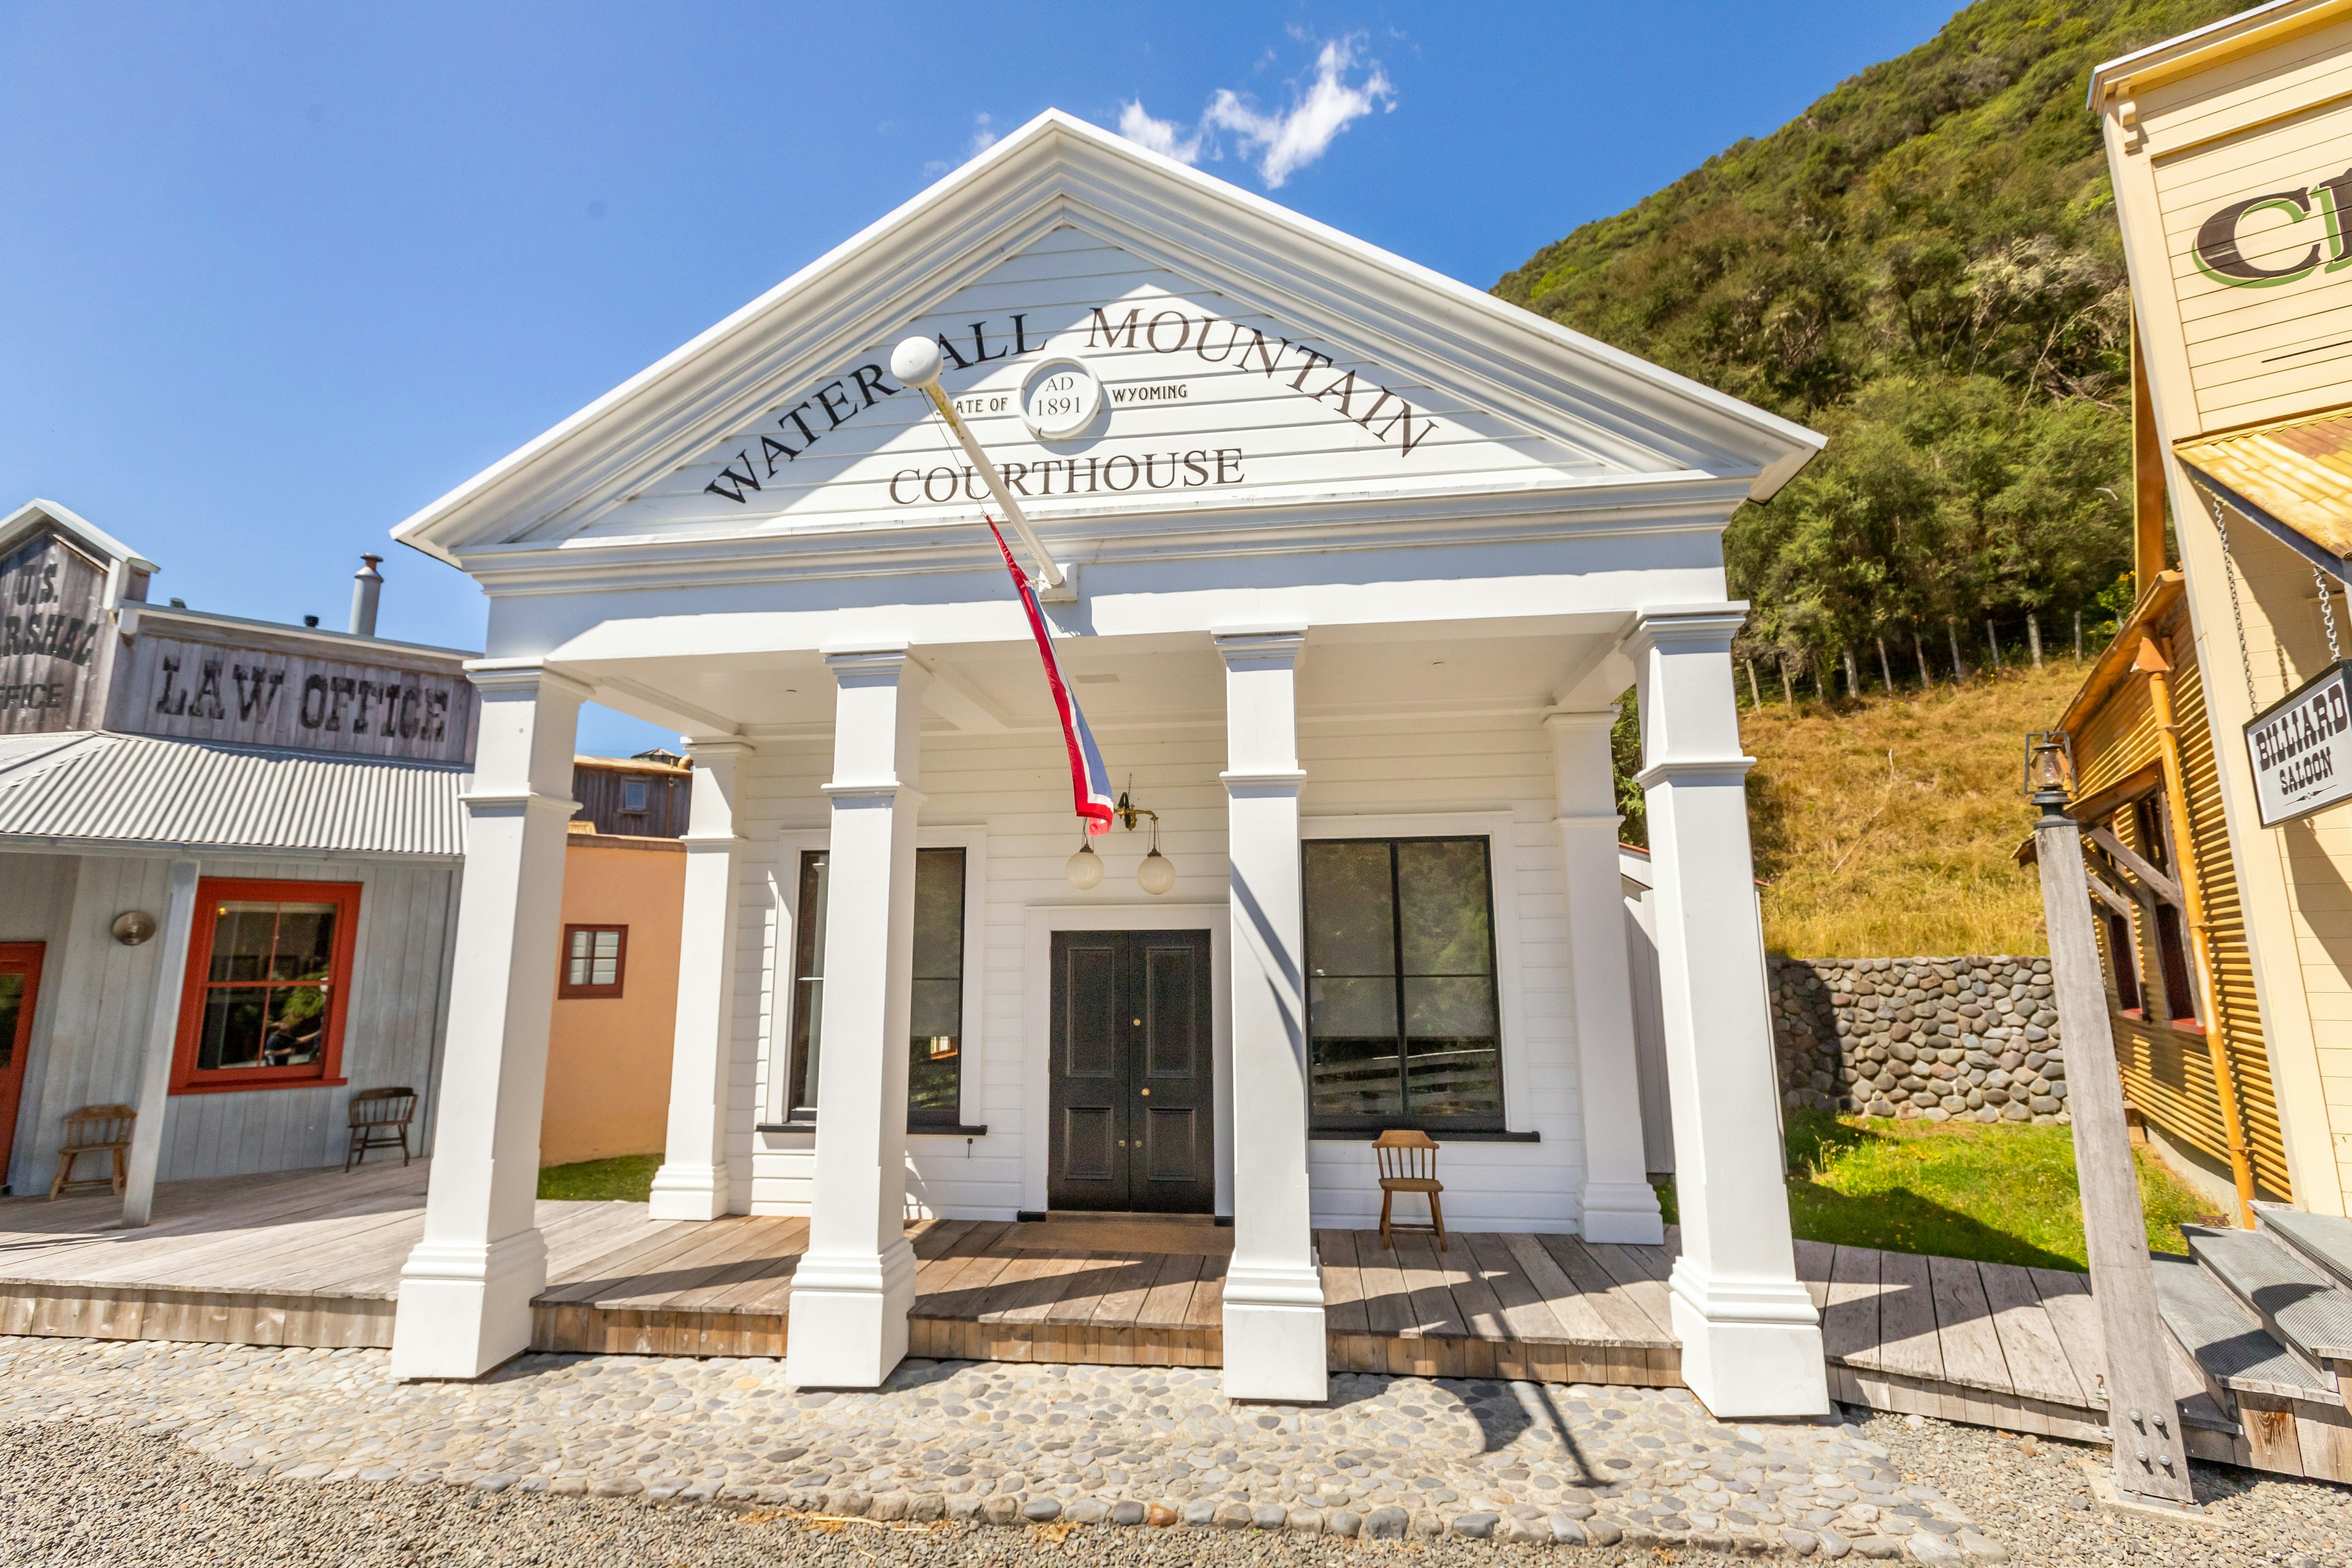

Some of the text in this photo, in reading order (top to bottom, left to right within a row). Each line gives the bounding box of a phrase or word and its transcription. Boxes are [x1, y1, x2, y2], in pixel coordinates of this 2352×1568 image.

[704, 307, 1439, 504] WATERALL MOUNTAIN
[935, 383, 1188, 415] ATE OF WYOMING
[1037, 396, 1081, 417] 1891
[1045, 376, 1074, 392] AD
[889, 448, 1245, 505] COURTHOUSE
[156, 652, 450, 742] LAW OFFICE
[2256, 684, 2348, 772] BILLIARD
[2280, 746, 2333, 795] SALOON
